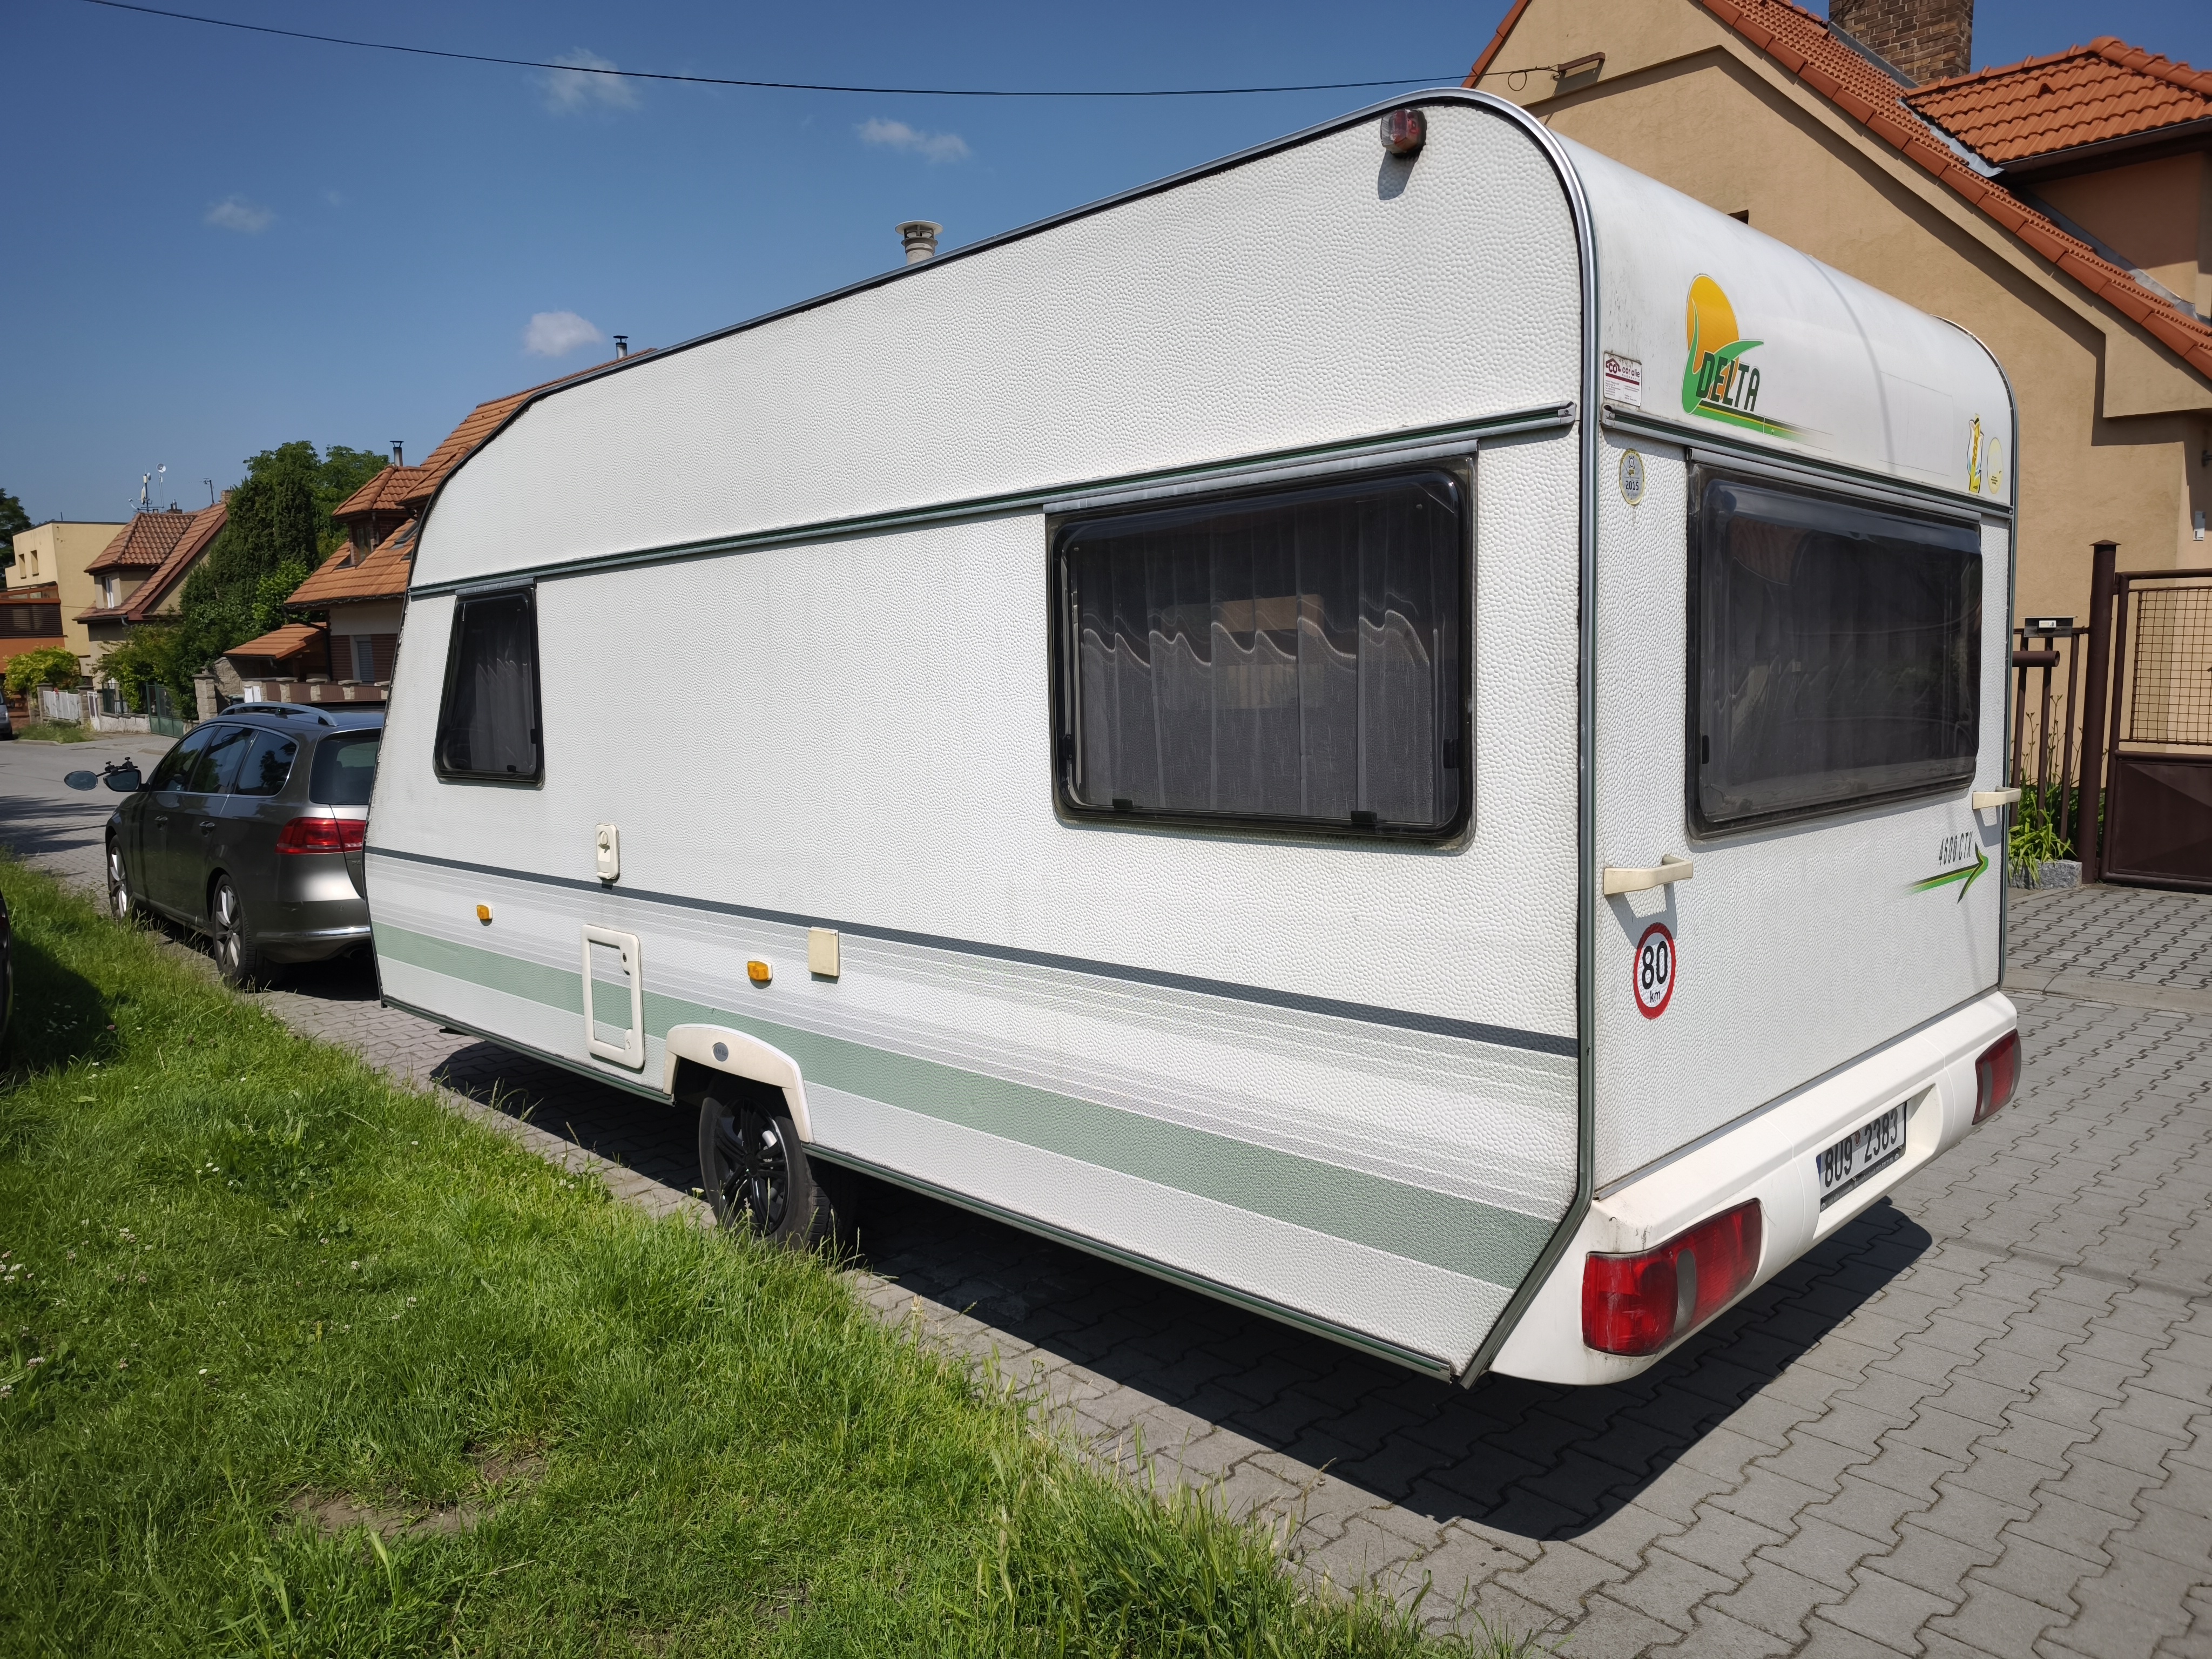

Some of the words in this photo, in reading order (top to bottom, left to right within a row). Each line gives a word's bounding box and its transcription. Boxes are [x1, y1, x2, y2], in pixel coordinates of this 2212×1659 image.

[1696, 352, 1761, 412] DELTA
[1626, 480, 1639, 490] 2015
[1939, 835, 1958, 866] 4600
[1642, 941, 1668, 990] 80
[1650, 990, 1661, 1002] km
[1825, 1136, 1852, 1188] 8U9
[1864, 1108, 1898, 1164] 2383
